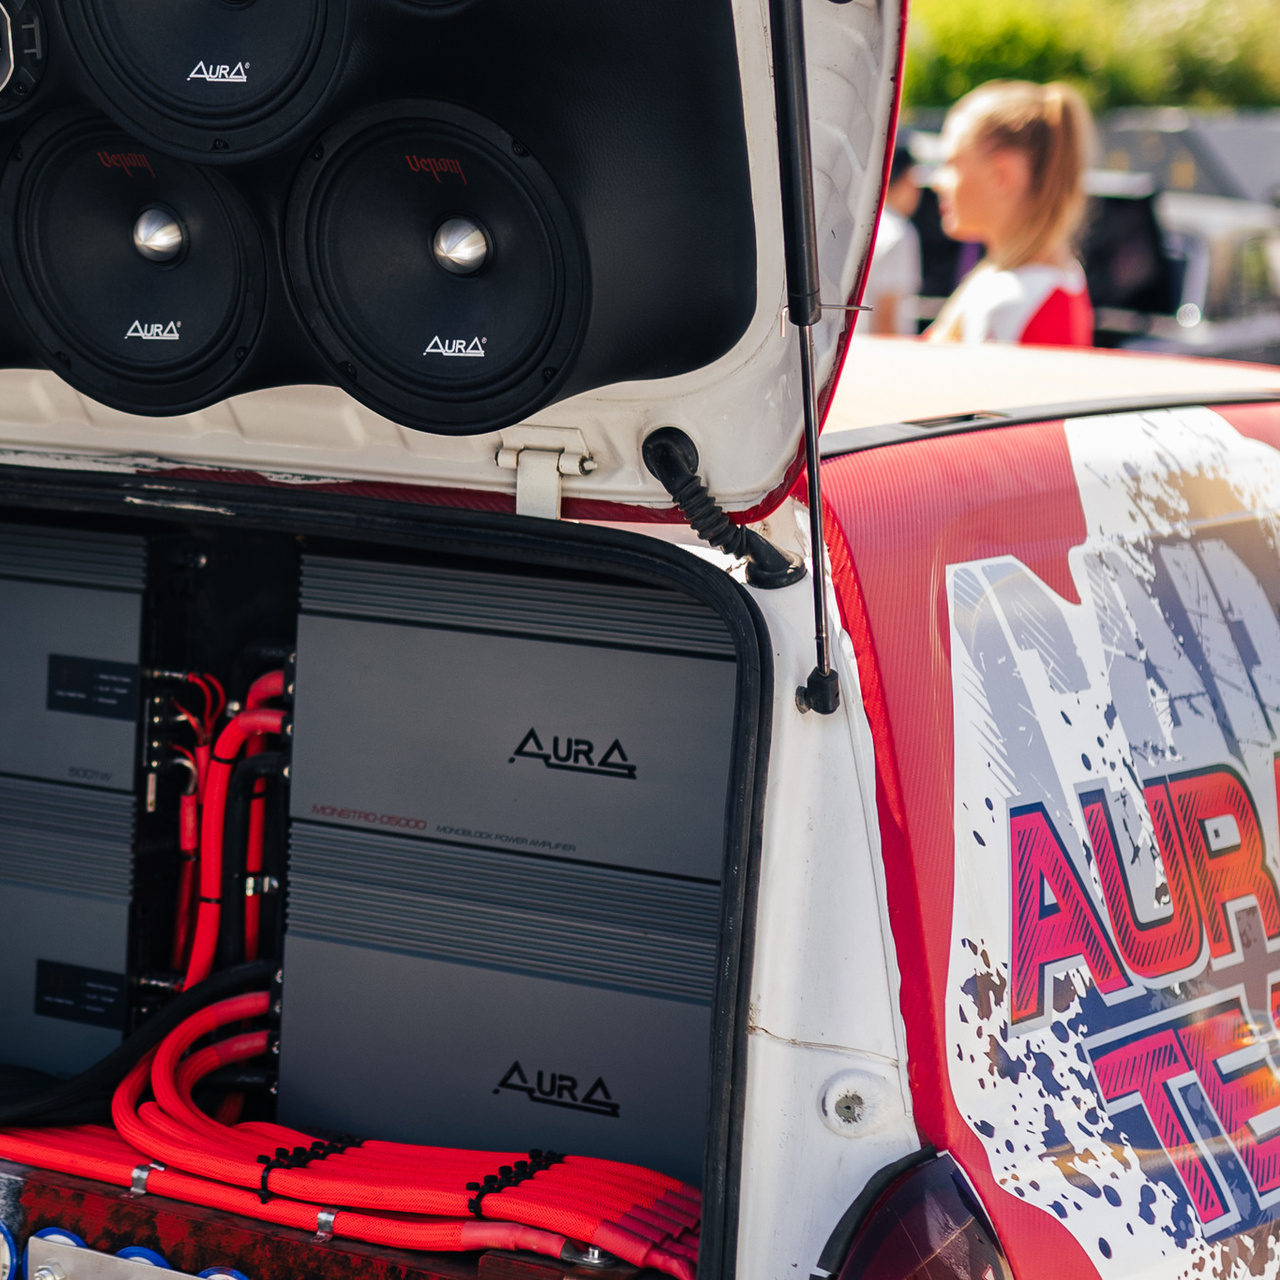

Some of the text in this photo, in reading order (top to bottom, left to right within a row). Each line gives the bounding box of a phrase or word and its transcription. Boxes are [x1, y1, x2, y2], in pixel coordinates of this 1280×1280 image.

[507, 726, 638, 780] AURA
[436, 824, 494, 842] MONOBLOCK
[494, 833, 529, 846] POWER
[529, 837, 577, 853] AMPLIFIER
[1008, 750, 1280, 1025] AUR
[491, 1059, 621, 1118] AURA
[1086, 990, 1280, 1235] TE
